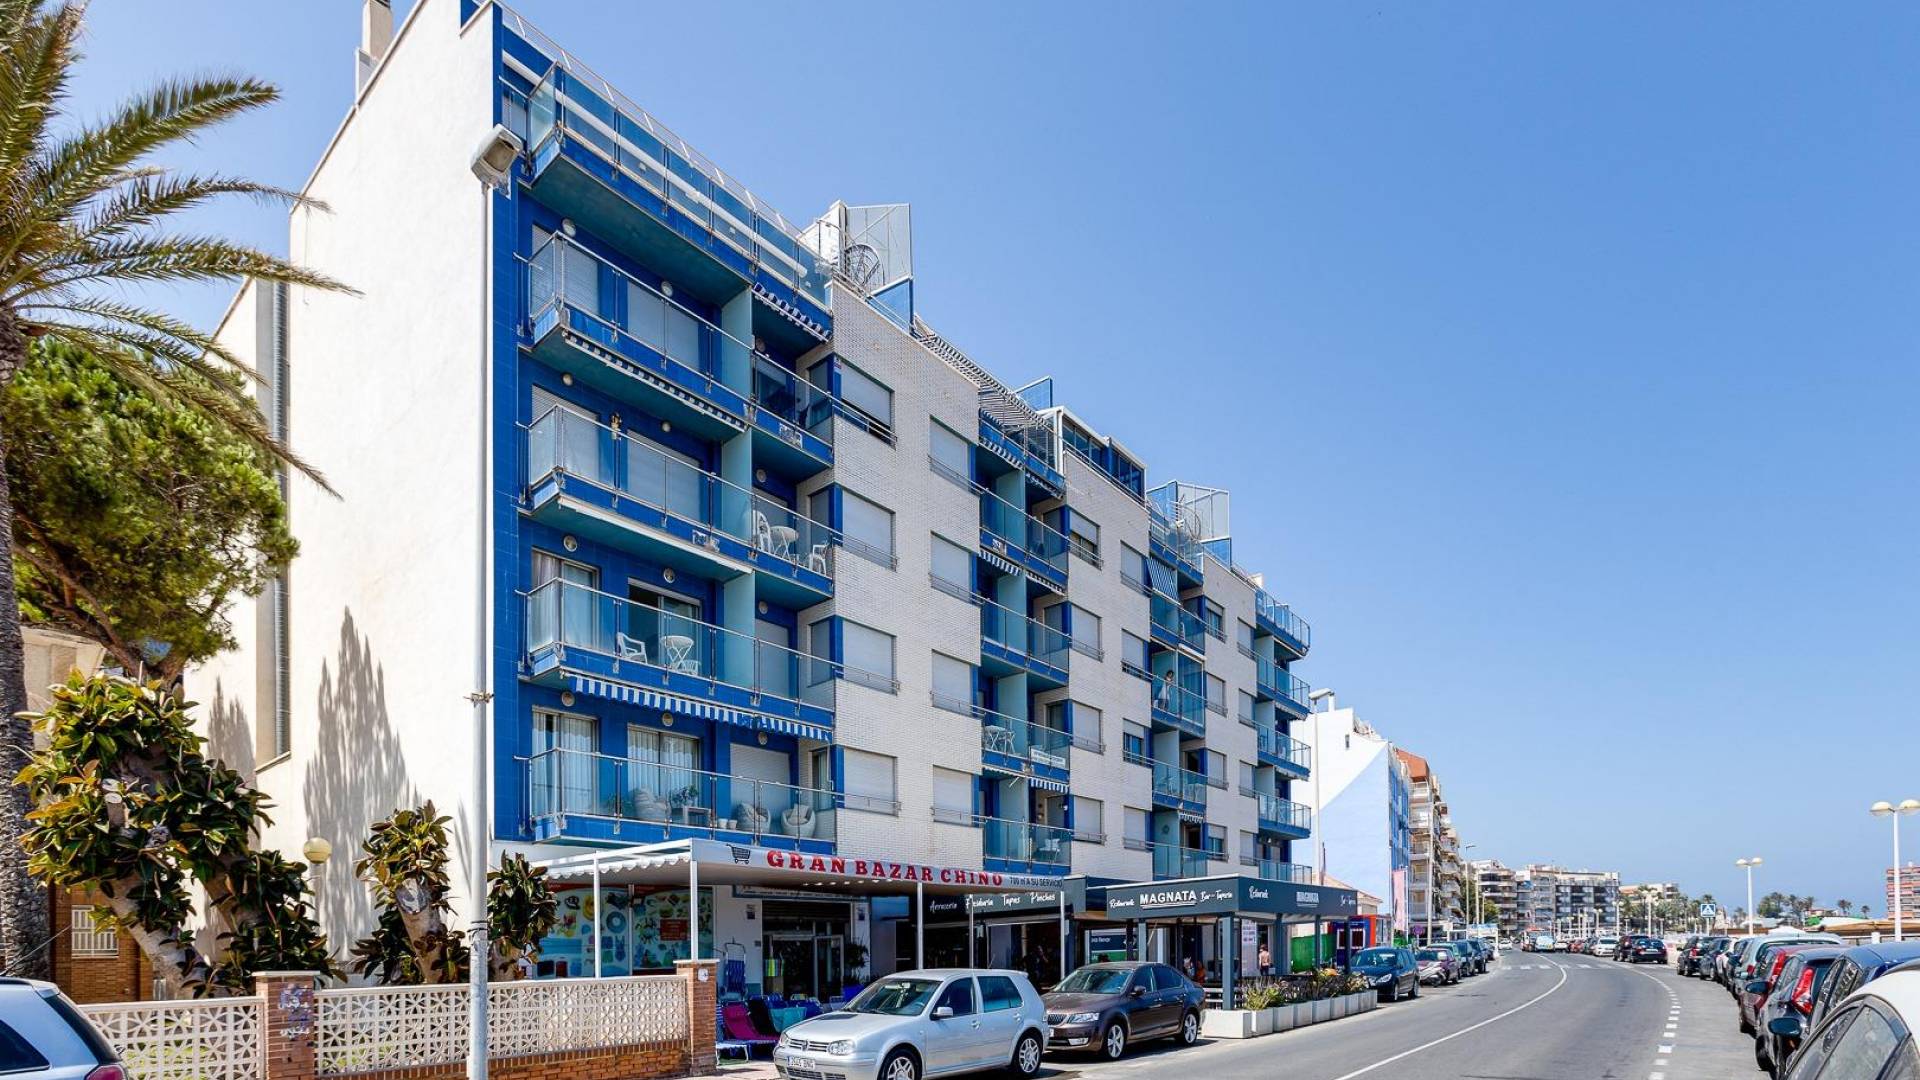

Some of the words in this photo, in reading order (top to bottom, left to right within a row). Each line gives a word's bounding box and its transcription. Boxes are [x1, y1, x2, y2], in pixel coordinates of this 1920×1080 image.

[767, 850, 845, 874] GRAN
[855, 860, 934, 882] BAZAR
[940, 869, 1003, 886] CHINO
[1039, 878, 1063, 888] SERVICIO
[1001, 893, 1021, 907] Tapas
[1140, 890, 1197, 905] MAGNATA
